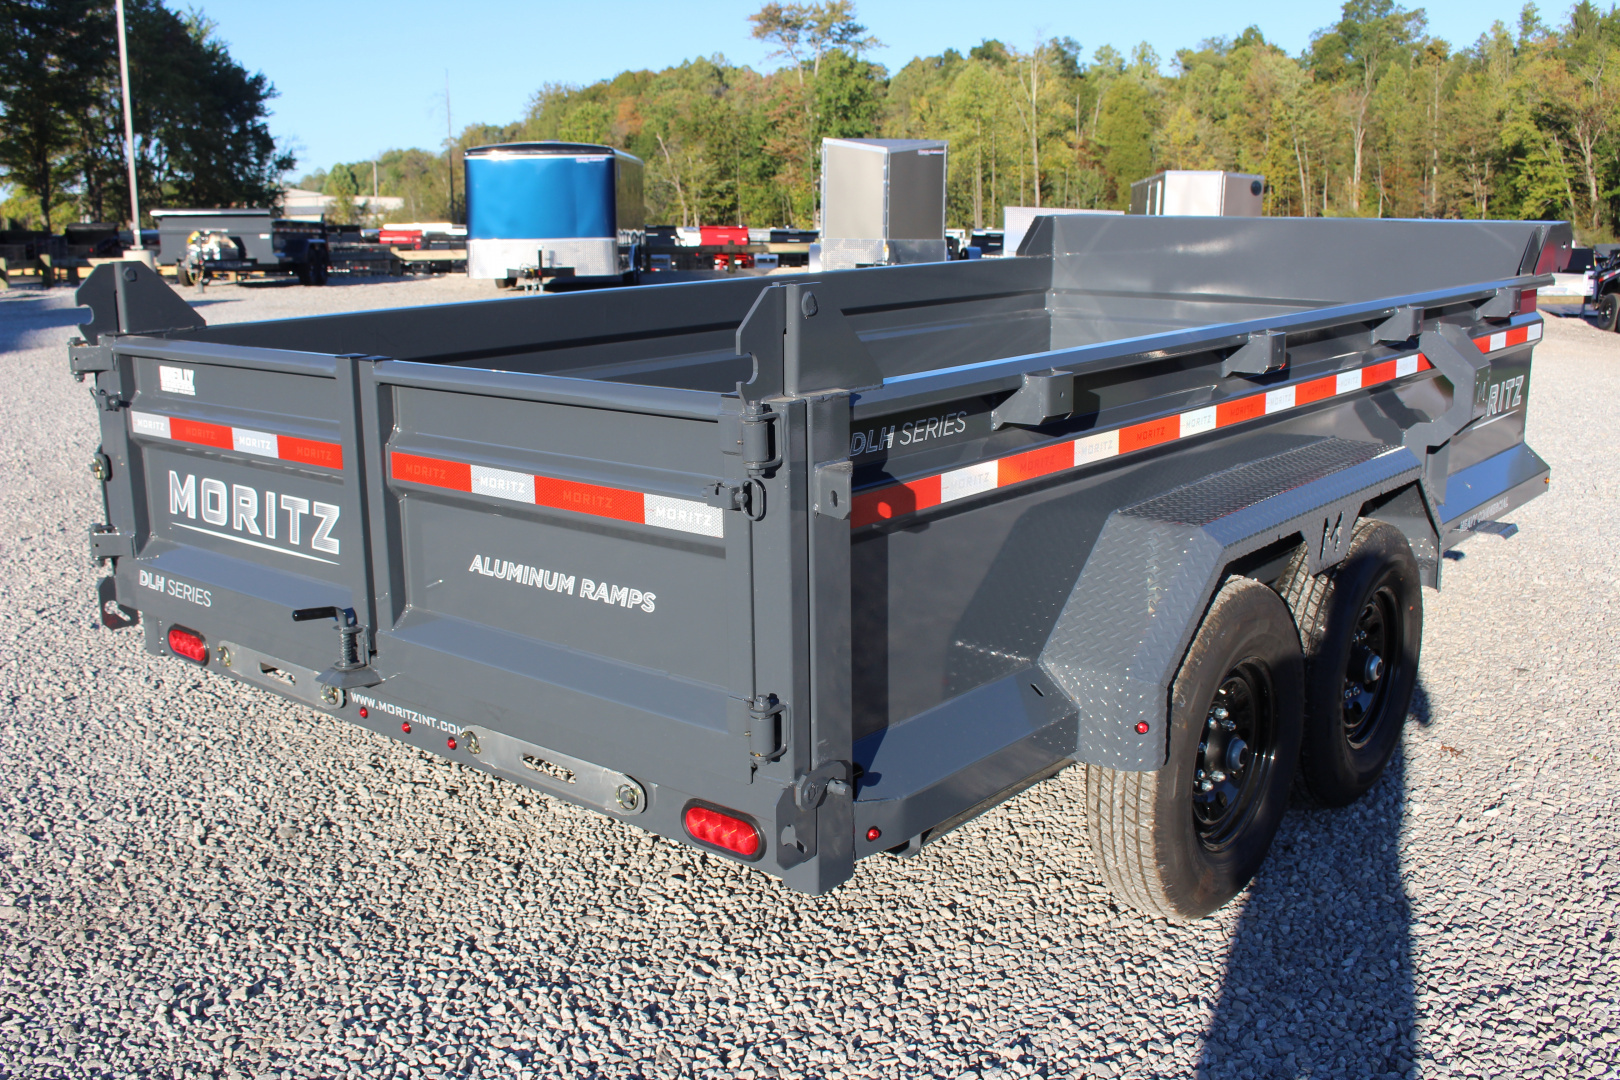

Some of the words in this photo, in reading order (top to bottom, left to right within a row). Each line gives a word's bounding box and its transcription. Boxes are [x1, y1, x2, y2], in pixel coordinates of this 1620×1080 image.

[1487, 374, 1525, 417] RITZ
[137, 418, 165, 431] MORITZ
[186, 426, 217, 440] MORITZ
[238, 436, 271, 450] MORITZ
[297, 446, 332, 461] MORITZ
[850, 425, 895, 456] DLH
[900, 411, 967, 445] SERIES
[951, 472, 990, 489] MORITZ
[1020, 455, 1055, 473] MORITZ
[1081, 439, 1113, 455] MORITZ
[1136, 426, 1165, 441] MORITZ
[1185, 414, 1212, 429] MORITZ
[1230, 404, 1254, 417] MORITZ
[1269, 393, 1292, 406] MORITZ
[169, 470, 340, 555] MORITZ
[405, 463, 446, 480] MORITZ
[480, 475, 526, 494] MORITZ
[563, 490, 613, 510] MORITZ
[655, 506, 713, 527] MORITZ
[139, 569, 165, 592] DLH
[168, 579, 212, 608] SERIES
[468, 554, 575, 595] ALUMINUM
[580, 578, 657, 613] RAMPS
